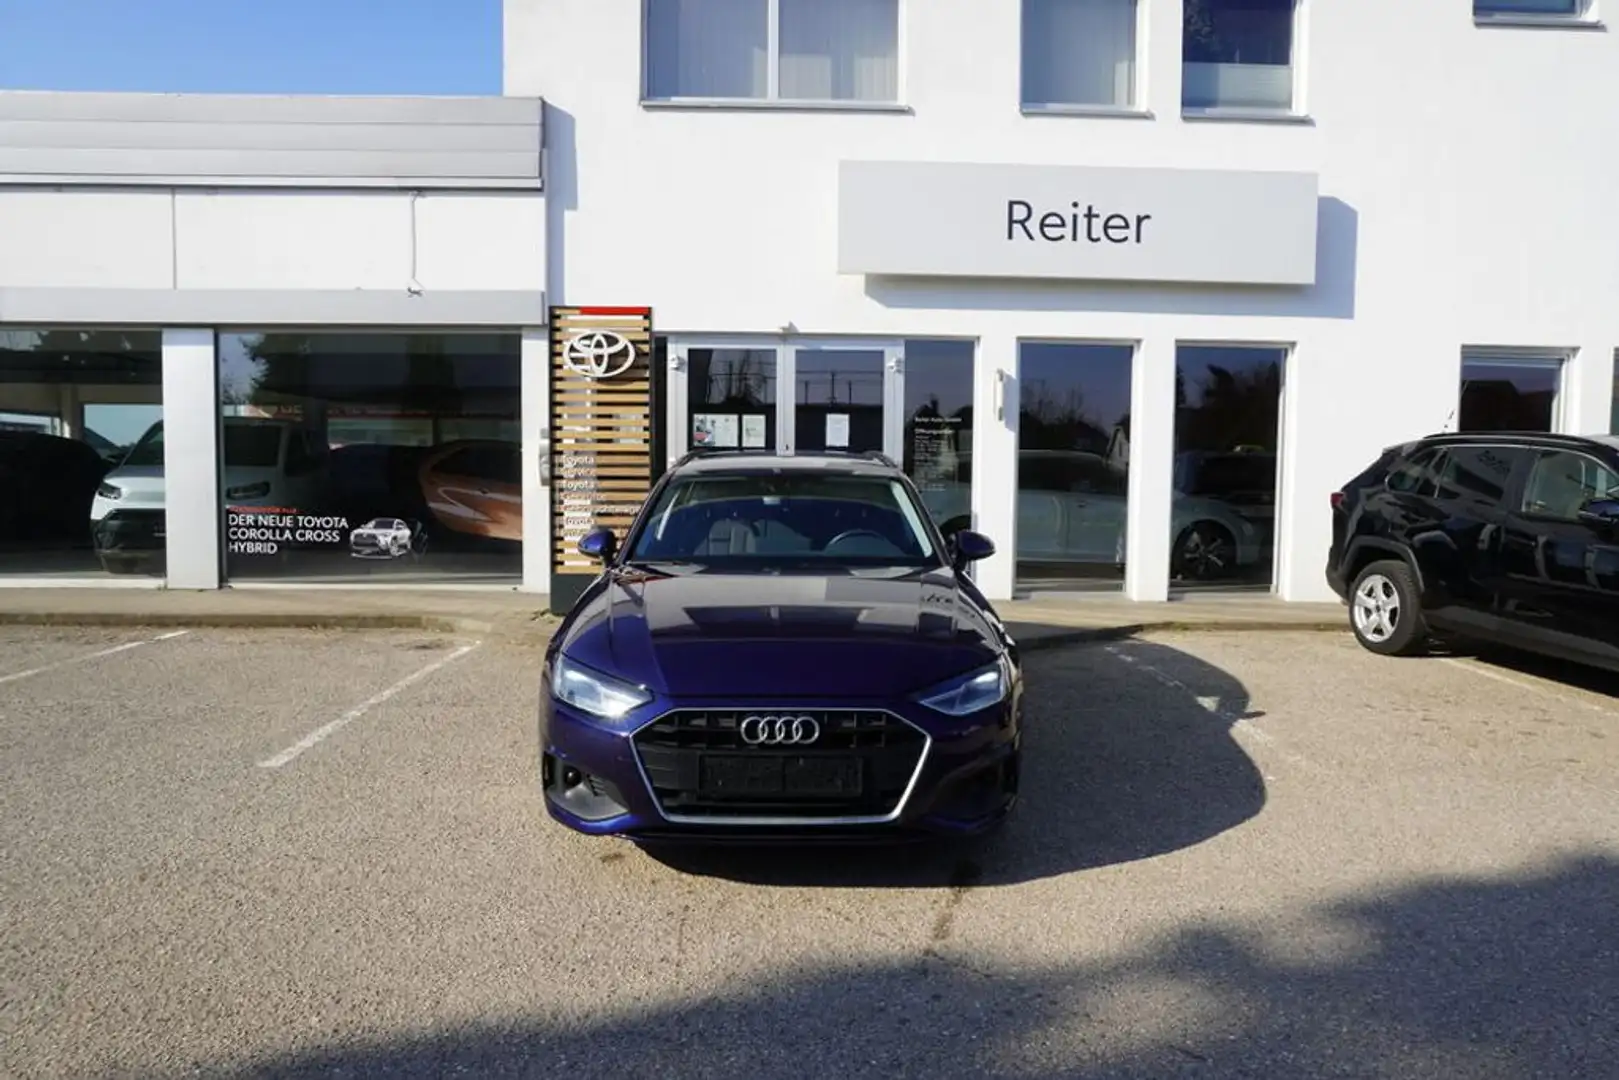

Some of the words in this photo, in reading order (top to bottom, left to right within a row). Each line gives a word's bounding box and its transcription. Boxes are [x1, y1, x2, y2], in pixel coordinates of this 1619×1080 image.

[1007, 199, 1152, 243] Reiter
[560, 454, 594, 467] Toyota
[560, 480, 594, 492] Toyota
[228, 514, 254, 526] DER
[258, 515, 294, 528] NEUE
[297, 515, 349, 529] TOYOTA
[228, 527, 293, 541] COROLLA
[295, 529, 340, 542] CROSS
[228, 541, 278, 554] HYBRID
